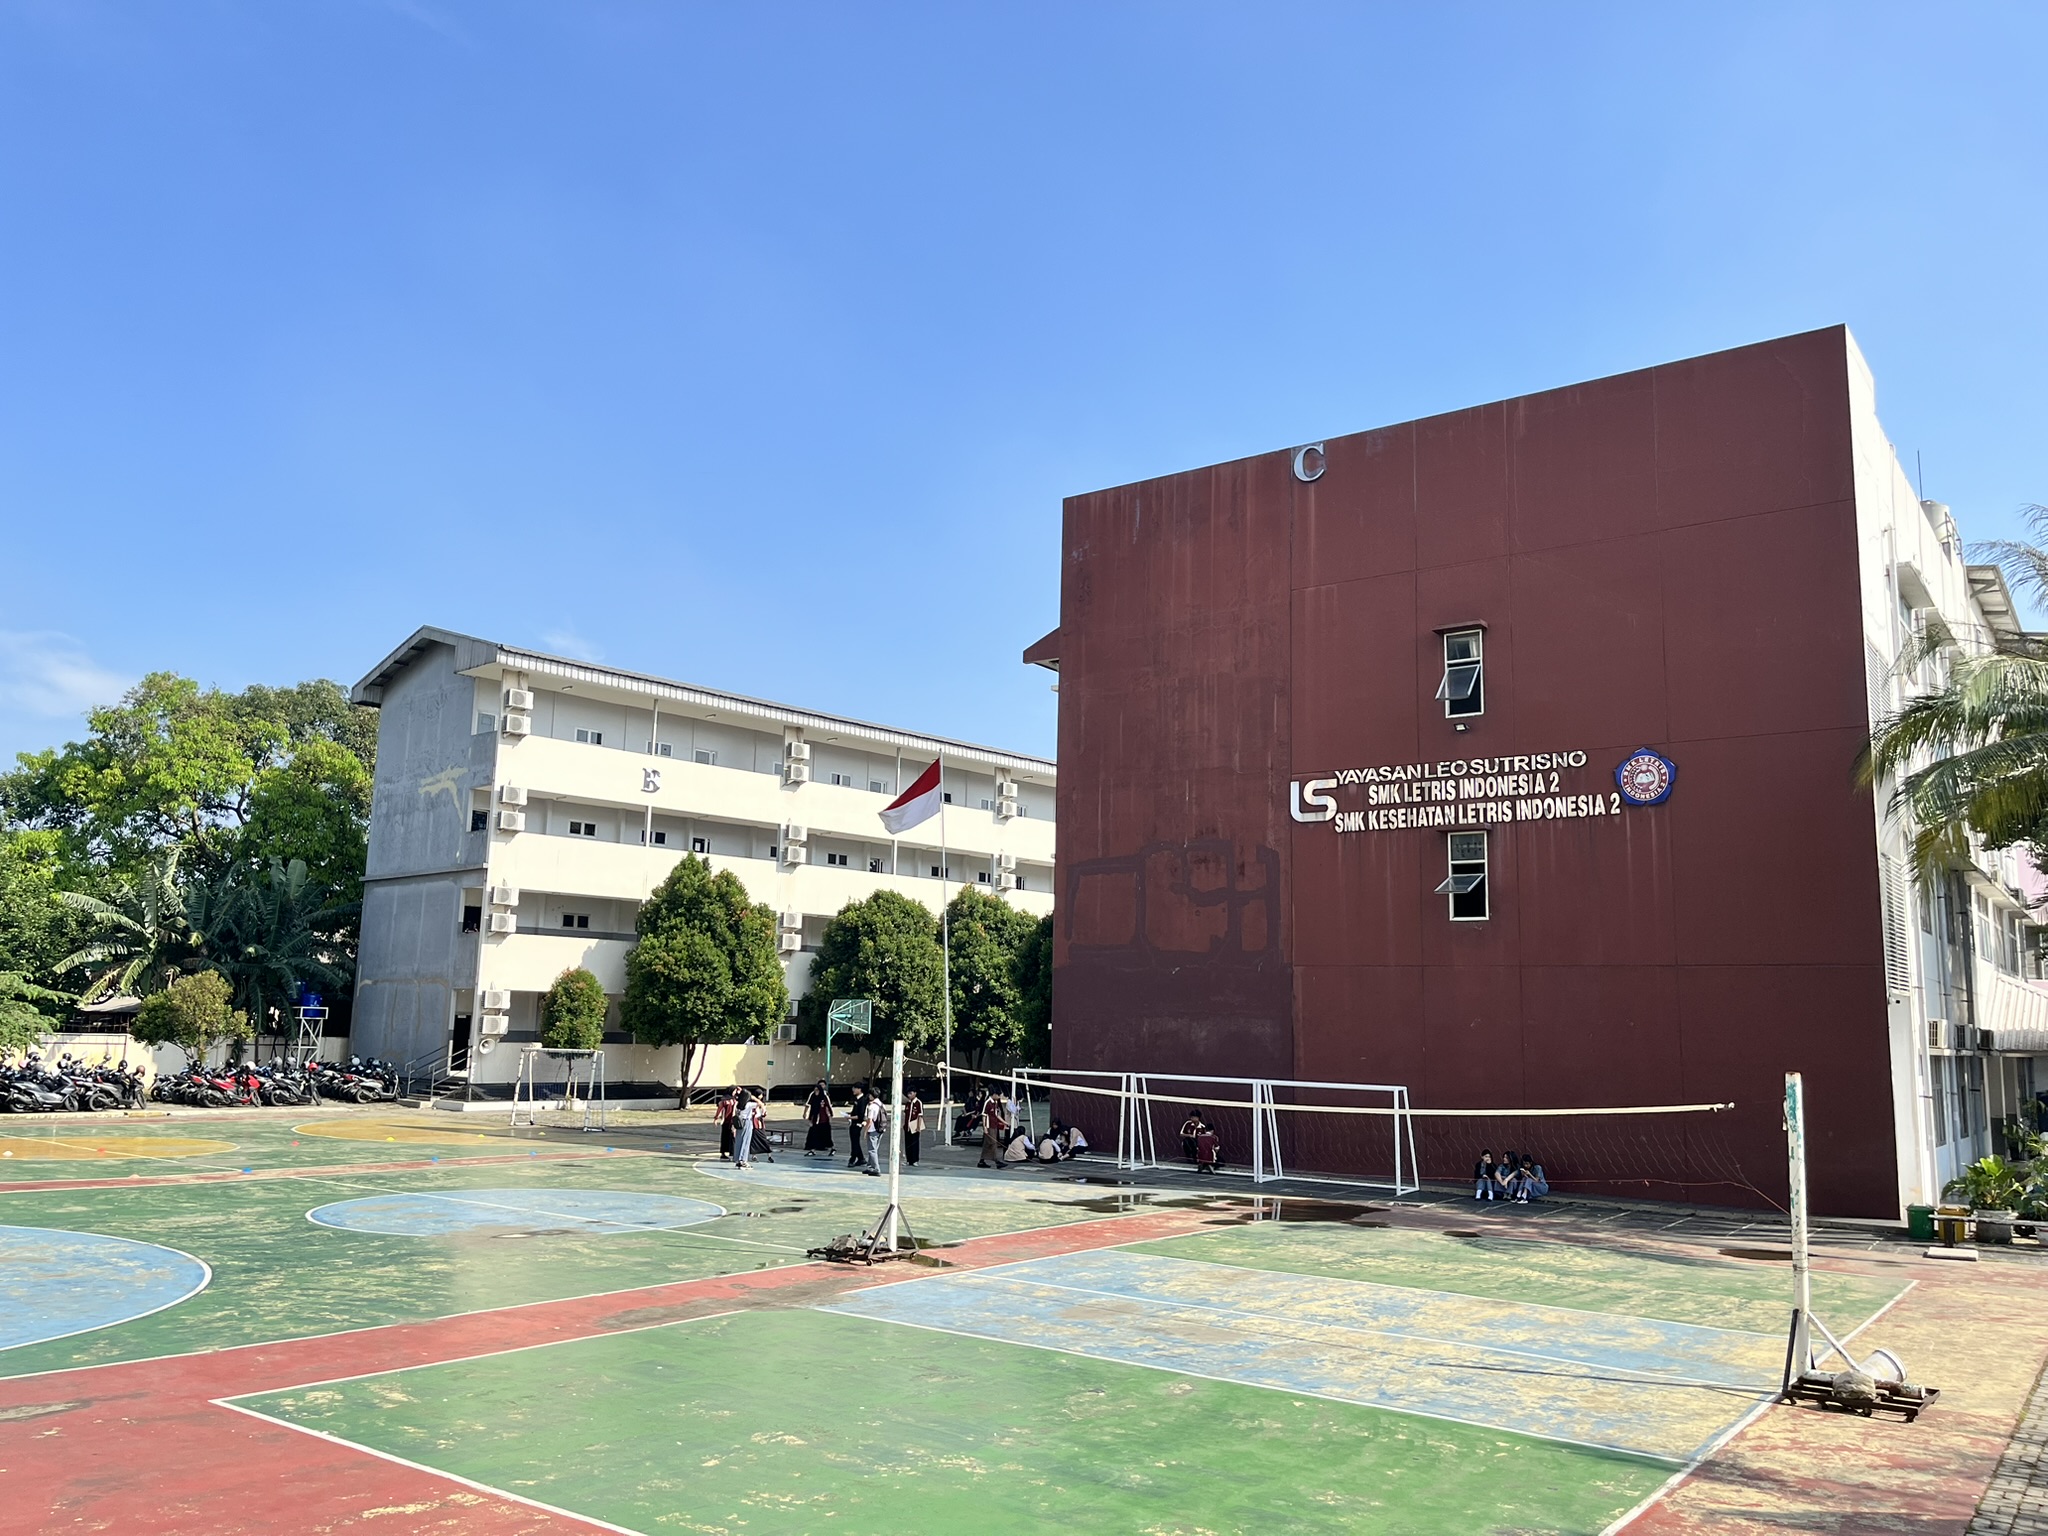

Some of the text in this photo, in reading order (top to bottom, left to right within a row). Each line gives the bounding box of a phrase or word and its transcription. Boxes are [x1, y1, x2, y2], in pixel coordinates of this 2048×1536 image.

[1293, 442, 1325, 482] C
[1334, 750, 1587, 785] YAYASAN LEO SUTRISNO
[1368, 771, 1560, 806] SMK LETRIS INDONESIA 2
[1334, 792, 1621, 834] SMK KESEHATAN LETRIS INDONESIA 2
